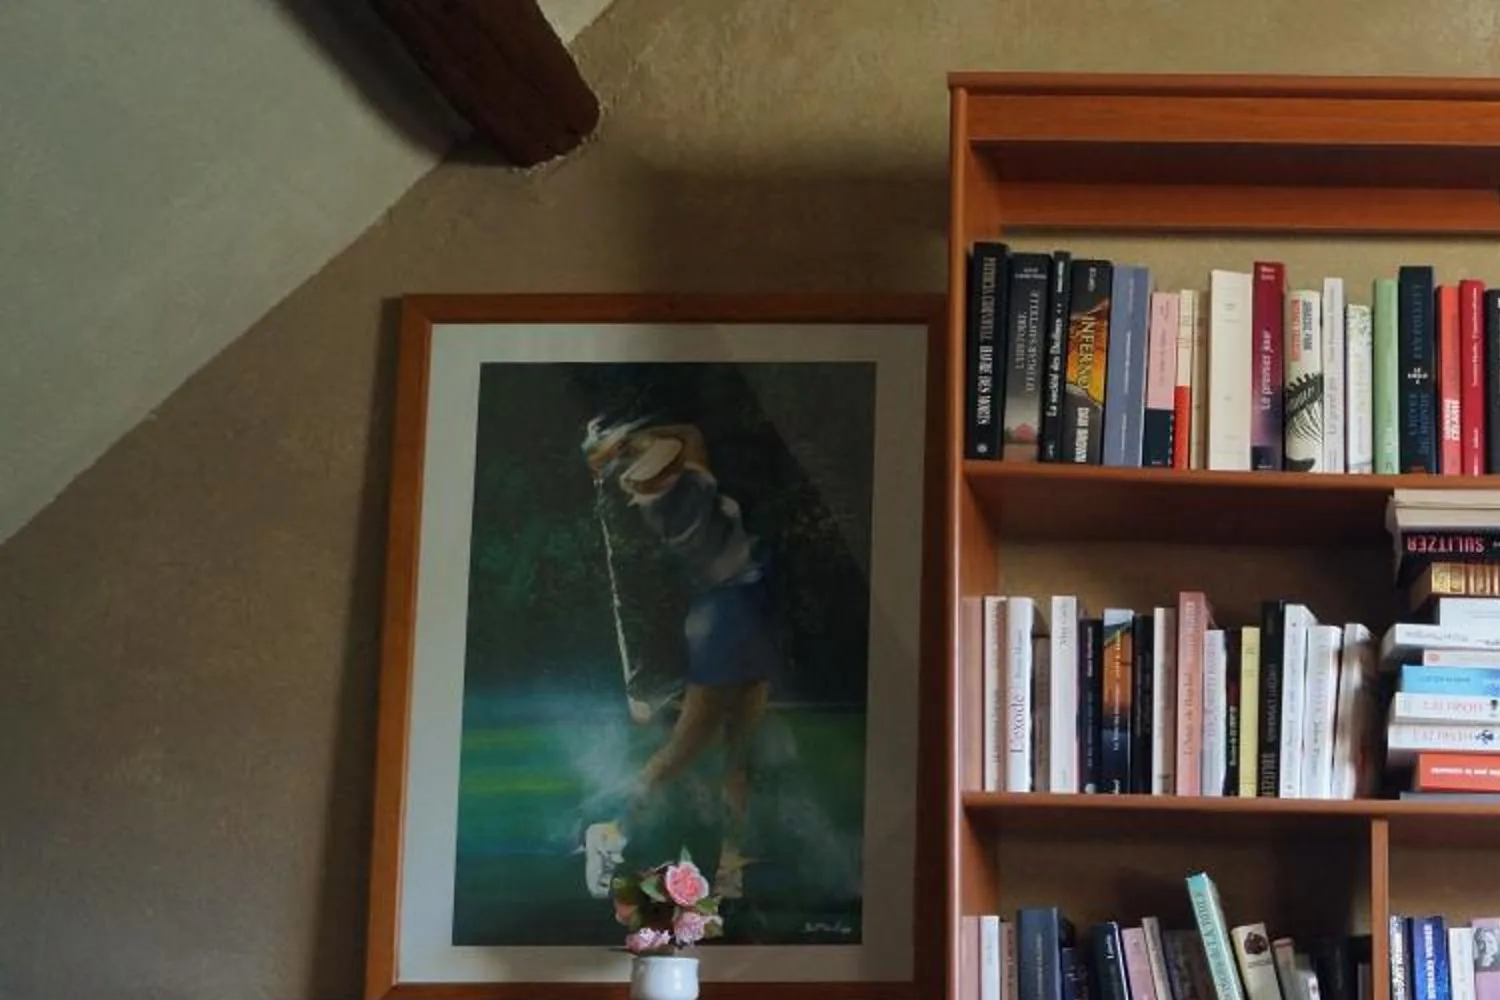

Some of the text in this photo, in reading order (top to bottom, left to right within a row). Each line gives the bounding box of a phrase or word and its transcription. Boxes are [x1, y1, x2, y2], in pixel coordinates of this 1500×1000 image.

[1078, 316, 1098, 393] INFERNO
[1407, 535, 1485, 553] SULITZER
[1009, 695, 1025, 754] L'exode
